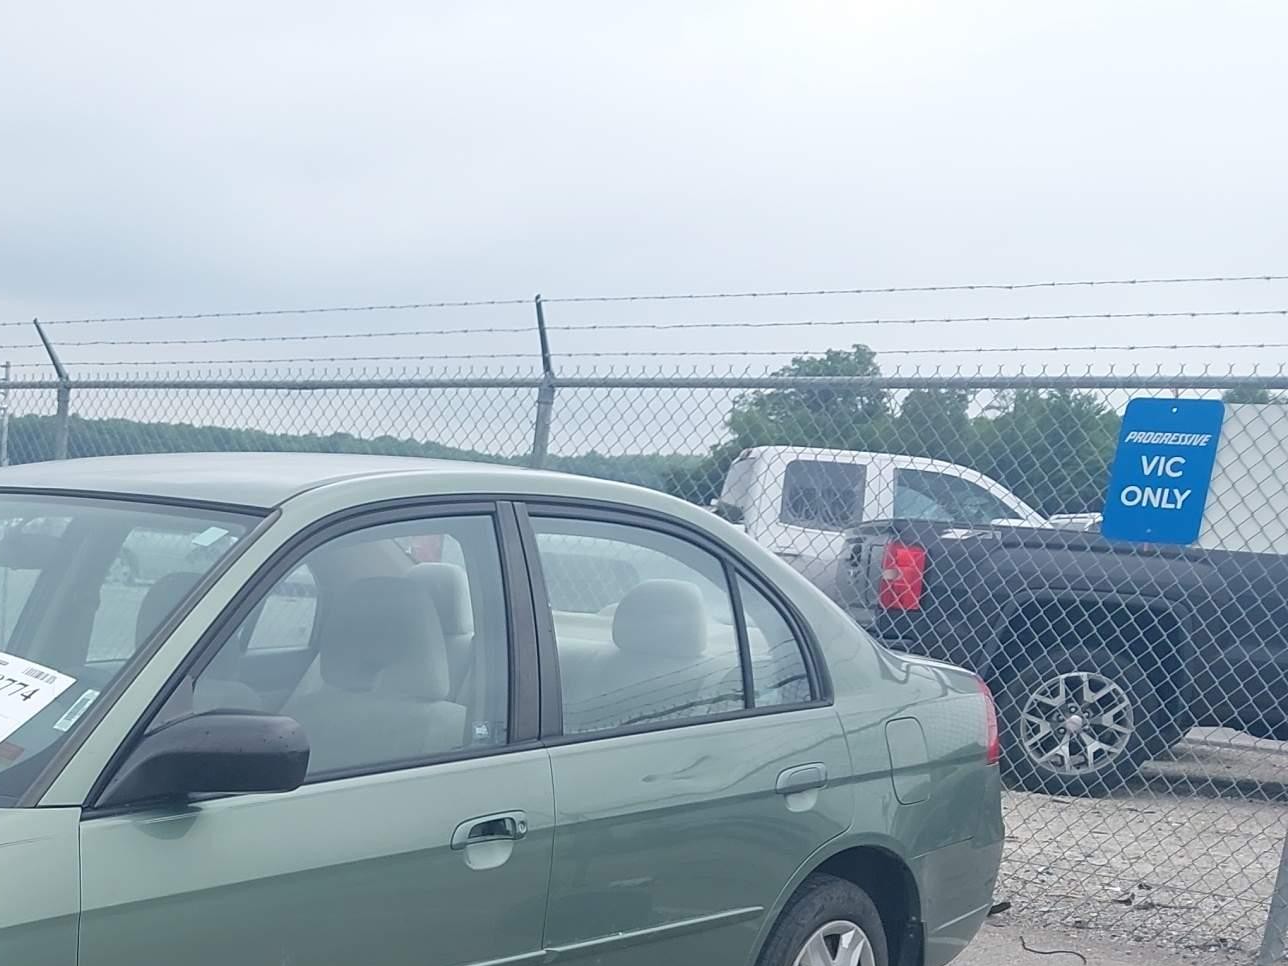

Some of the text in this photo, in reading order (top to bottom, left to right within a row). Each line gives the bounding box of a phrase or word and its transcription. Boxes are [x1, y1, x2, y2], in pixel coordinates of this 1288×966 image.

[1125, 431, 1212, 446] PROGRESSIVE
[1141, 455, 1186, 477] VIC
[1120, 485, 1191, 509] ONLY
